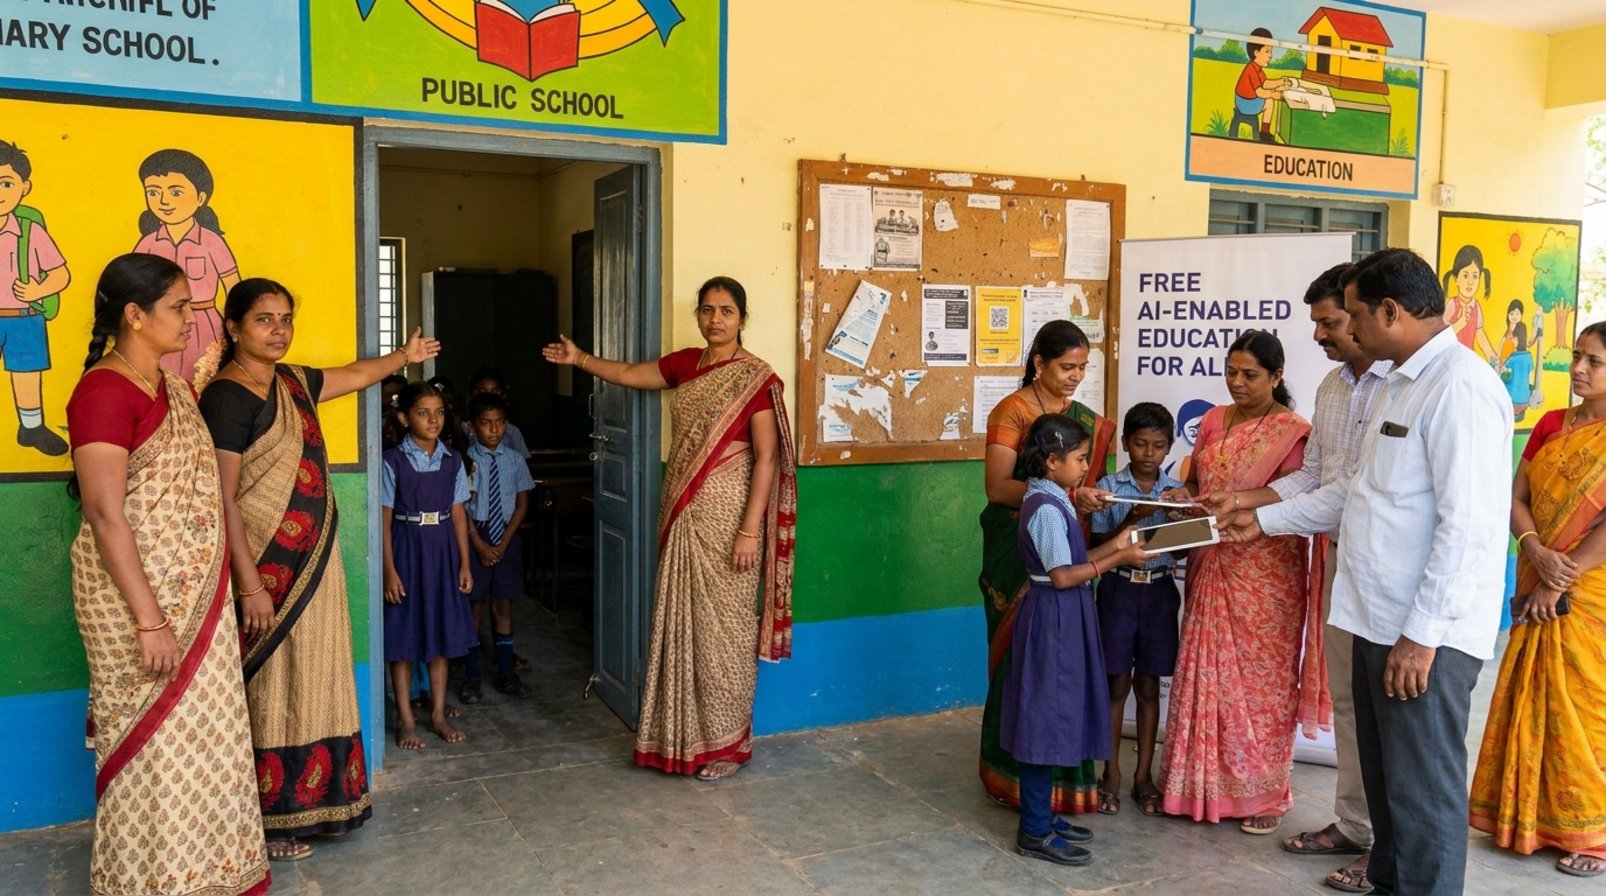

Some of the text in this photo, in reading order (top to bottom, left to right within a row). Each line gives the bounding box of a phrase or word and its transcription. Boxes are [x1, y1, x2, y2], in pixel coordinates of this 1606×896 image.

[0, 18, 220, 66] ARY SCHOOL.
[421, 77, 624, 119] PUBLIC SCHOOL
[1263, 154, 1354, 181] EDUCATION
[1139, 272, 1202, 293] FREE
[1137, 300, 1292, 321] AI-ENABLED
[1138, 328, 1278, 348] EDUCAT
[1137, 356, 1183, 376] FOR
